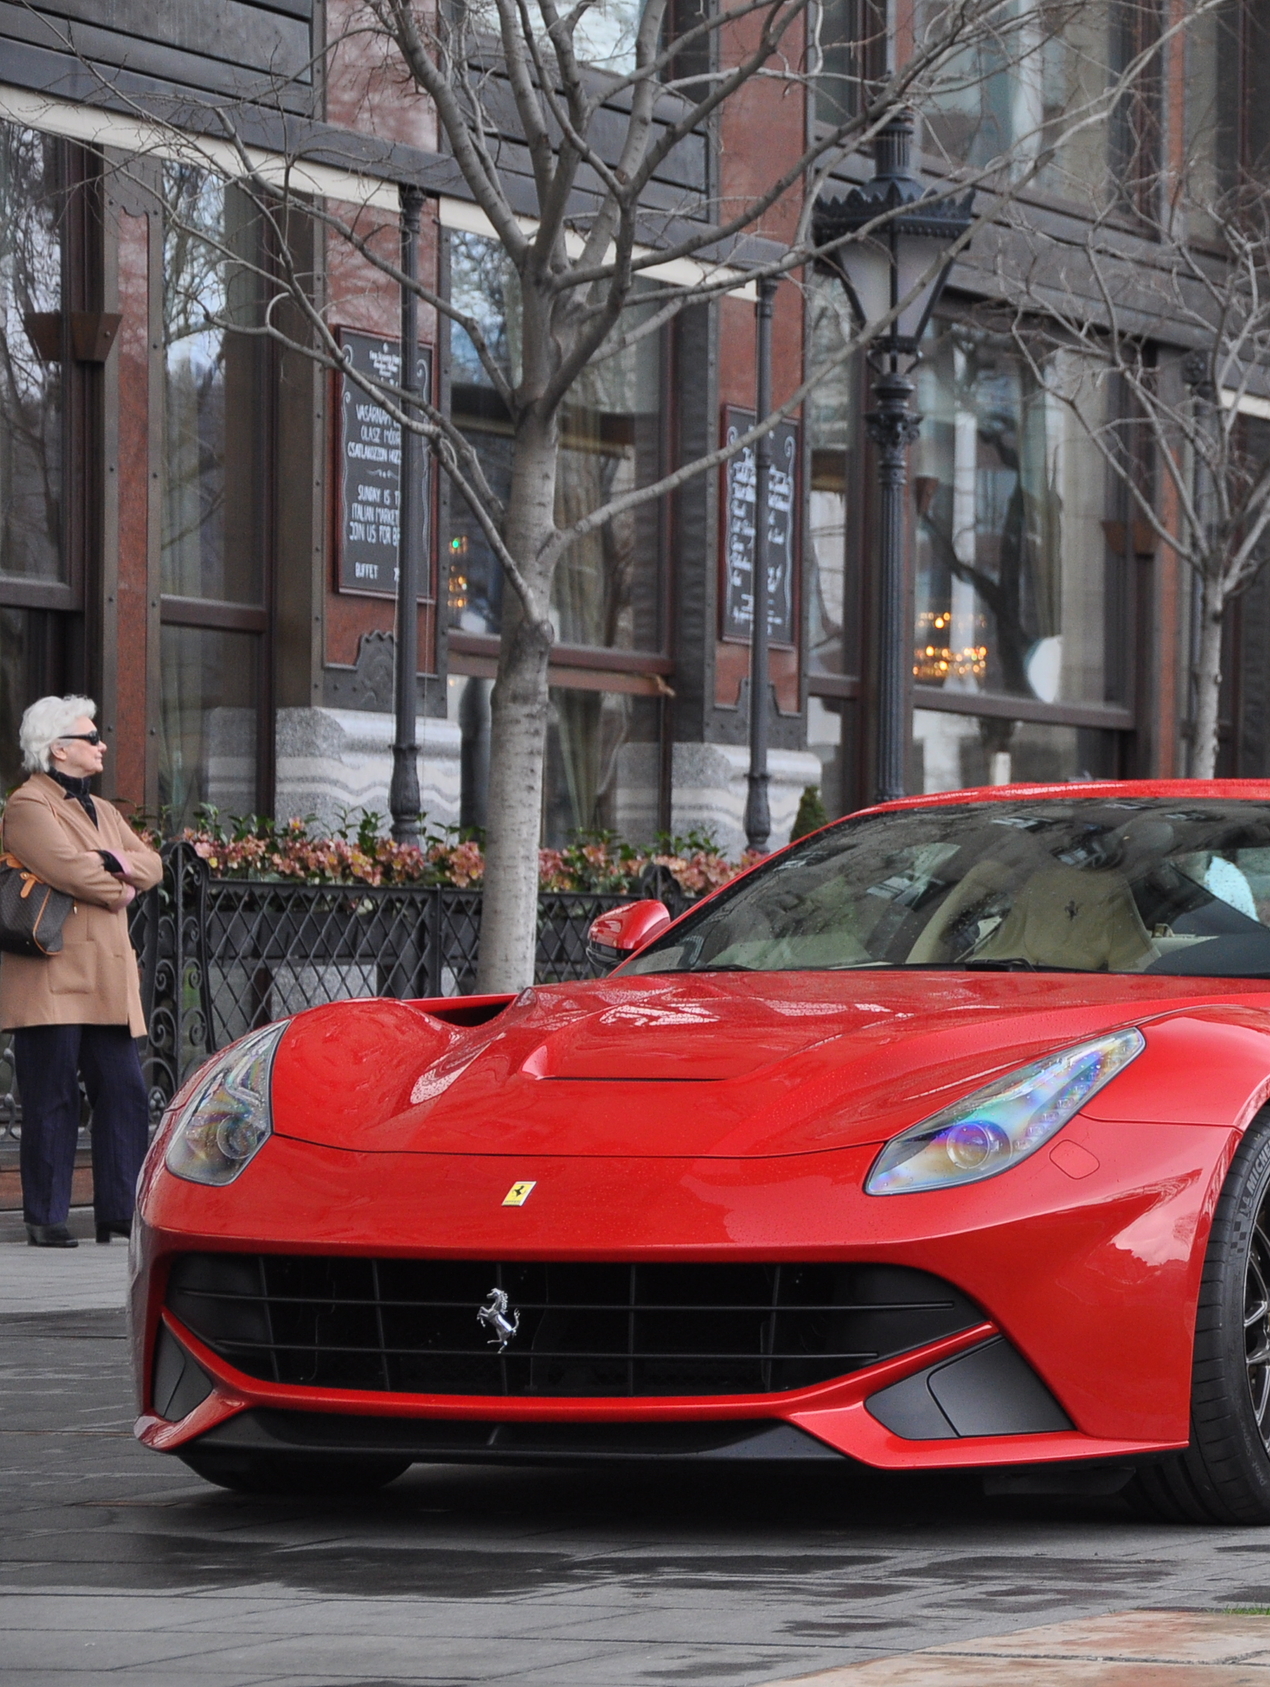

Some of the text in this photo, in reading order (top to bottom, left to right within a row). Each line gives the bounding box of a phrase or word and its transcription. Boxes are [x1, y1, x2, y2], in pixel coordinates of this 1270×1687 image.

[361, 424, 381, 443] OLASZ
[358, 484, 381, 503] SUNDAY
[383, 489, 391, 506] IS
[351, 502, 400, 526] ITALIAN MARKET
[349, 521, 366, 541] JOIN
[366, 523, 377, 544] US
[378, 525, 392, 545] FOR
[355, 561, 379, 580] BUFFET
